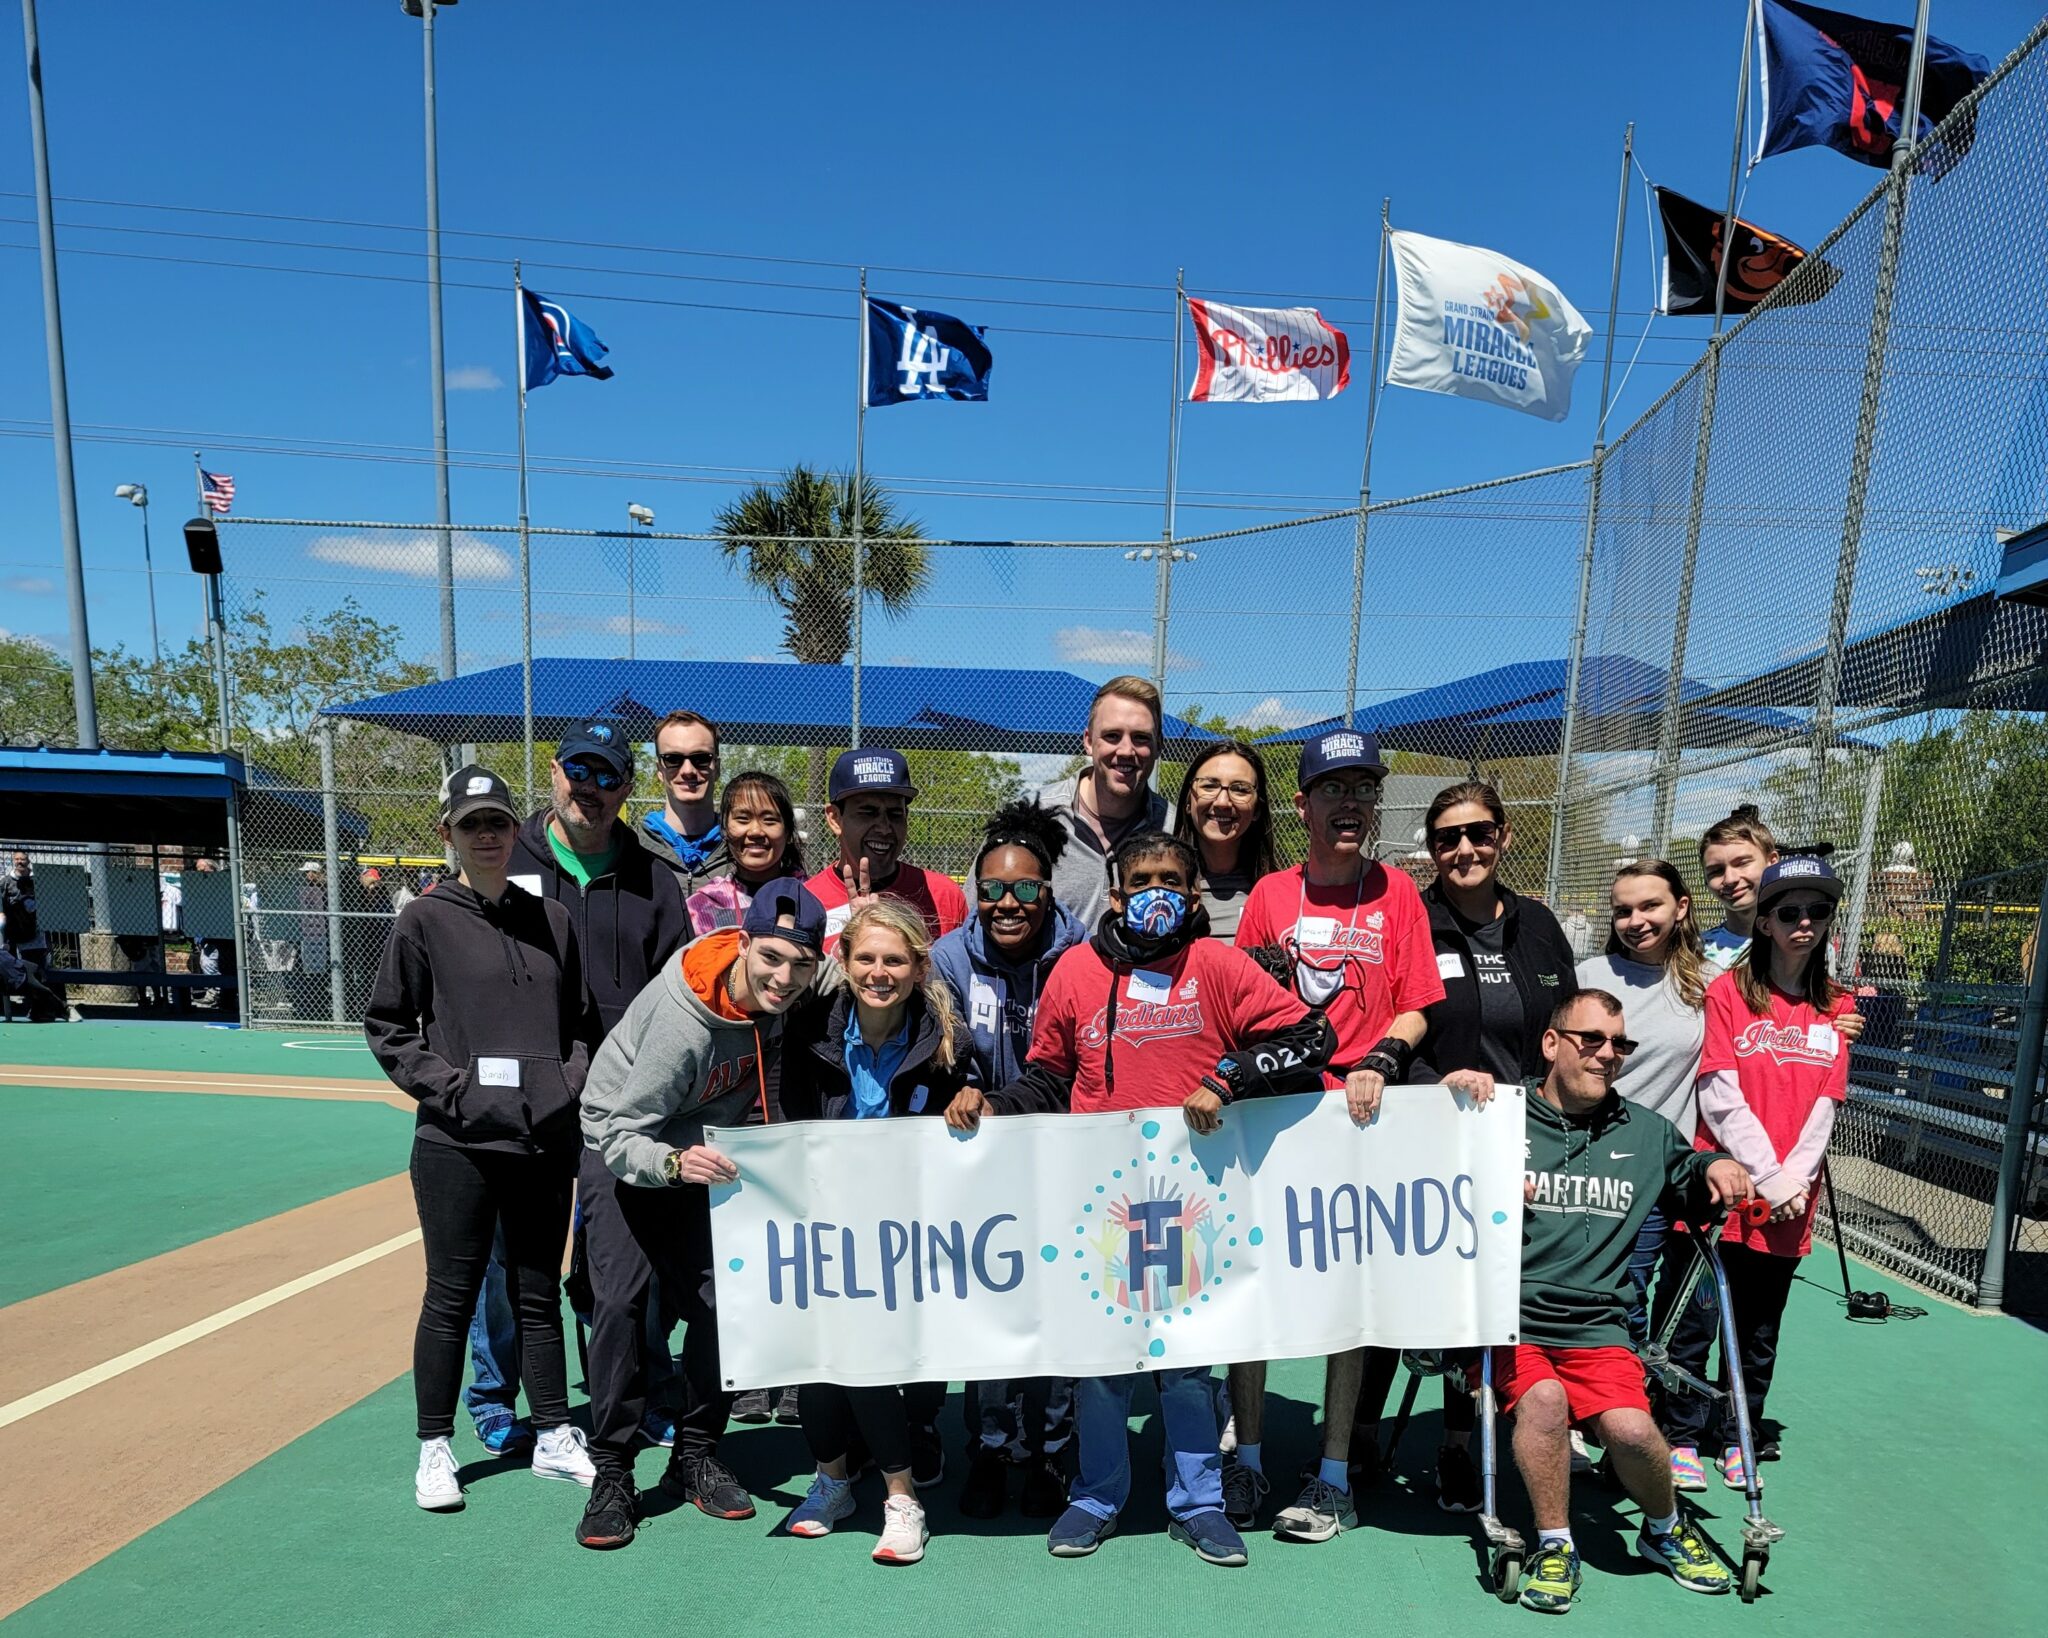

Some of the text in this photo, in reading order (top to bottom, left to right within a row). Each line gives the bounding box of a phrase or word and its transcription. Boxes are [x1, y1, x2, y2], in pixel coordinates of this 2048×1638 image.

[1445, 300, 1469, 314] GRAND
[897, 306, 950, 394] LA
[1212, 329, 1335, 375] Phillies
[1452, 350, 1528, 390] LEAGUES
[1321, 738, 1365, 755] MIRACLE
[1326, 749, 1362, 760] LEAGUES
[853, 762, 895, 775] MIRACLE
[859, 774, 892, 783] LEAGUES
[1779, 863, 1821, 878] MIRACLE
[766, 1174, 1478, 1311] HELPING HANDS
